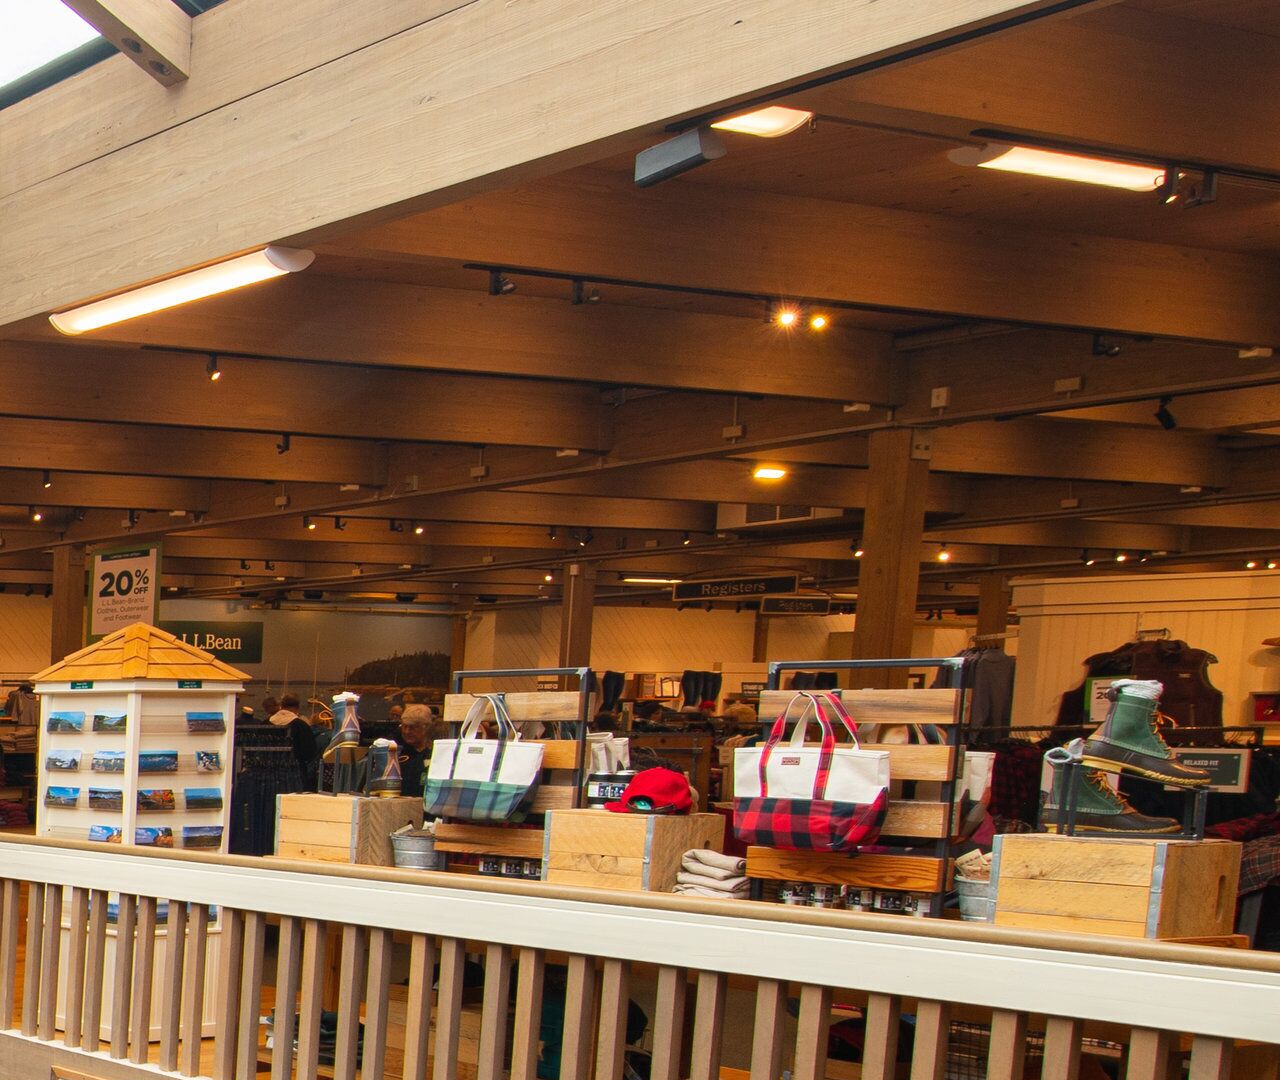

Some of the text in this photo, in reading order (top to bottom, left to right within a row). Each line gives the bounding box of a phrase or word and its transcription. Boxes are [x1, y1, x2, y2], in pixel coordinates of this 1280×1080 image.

[99, 568, 150, 598] 20%
[134, 586, 149, 595] OFF
[701, 582, 767, 596] Registers
[182, 633, 242, 650] LL.Bean
